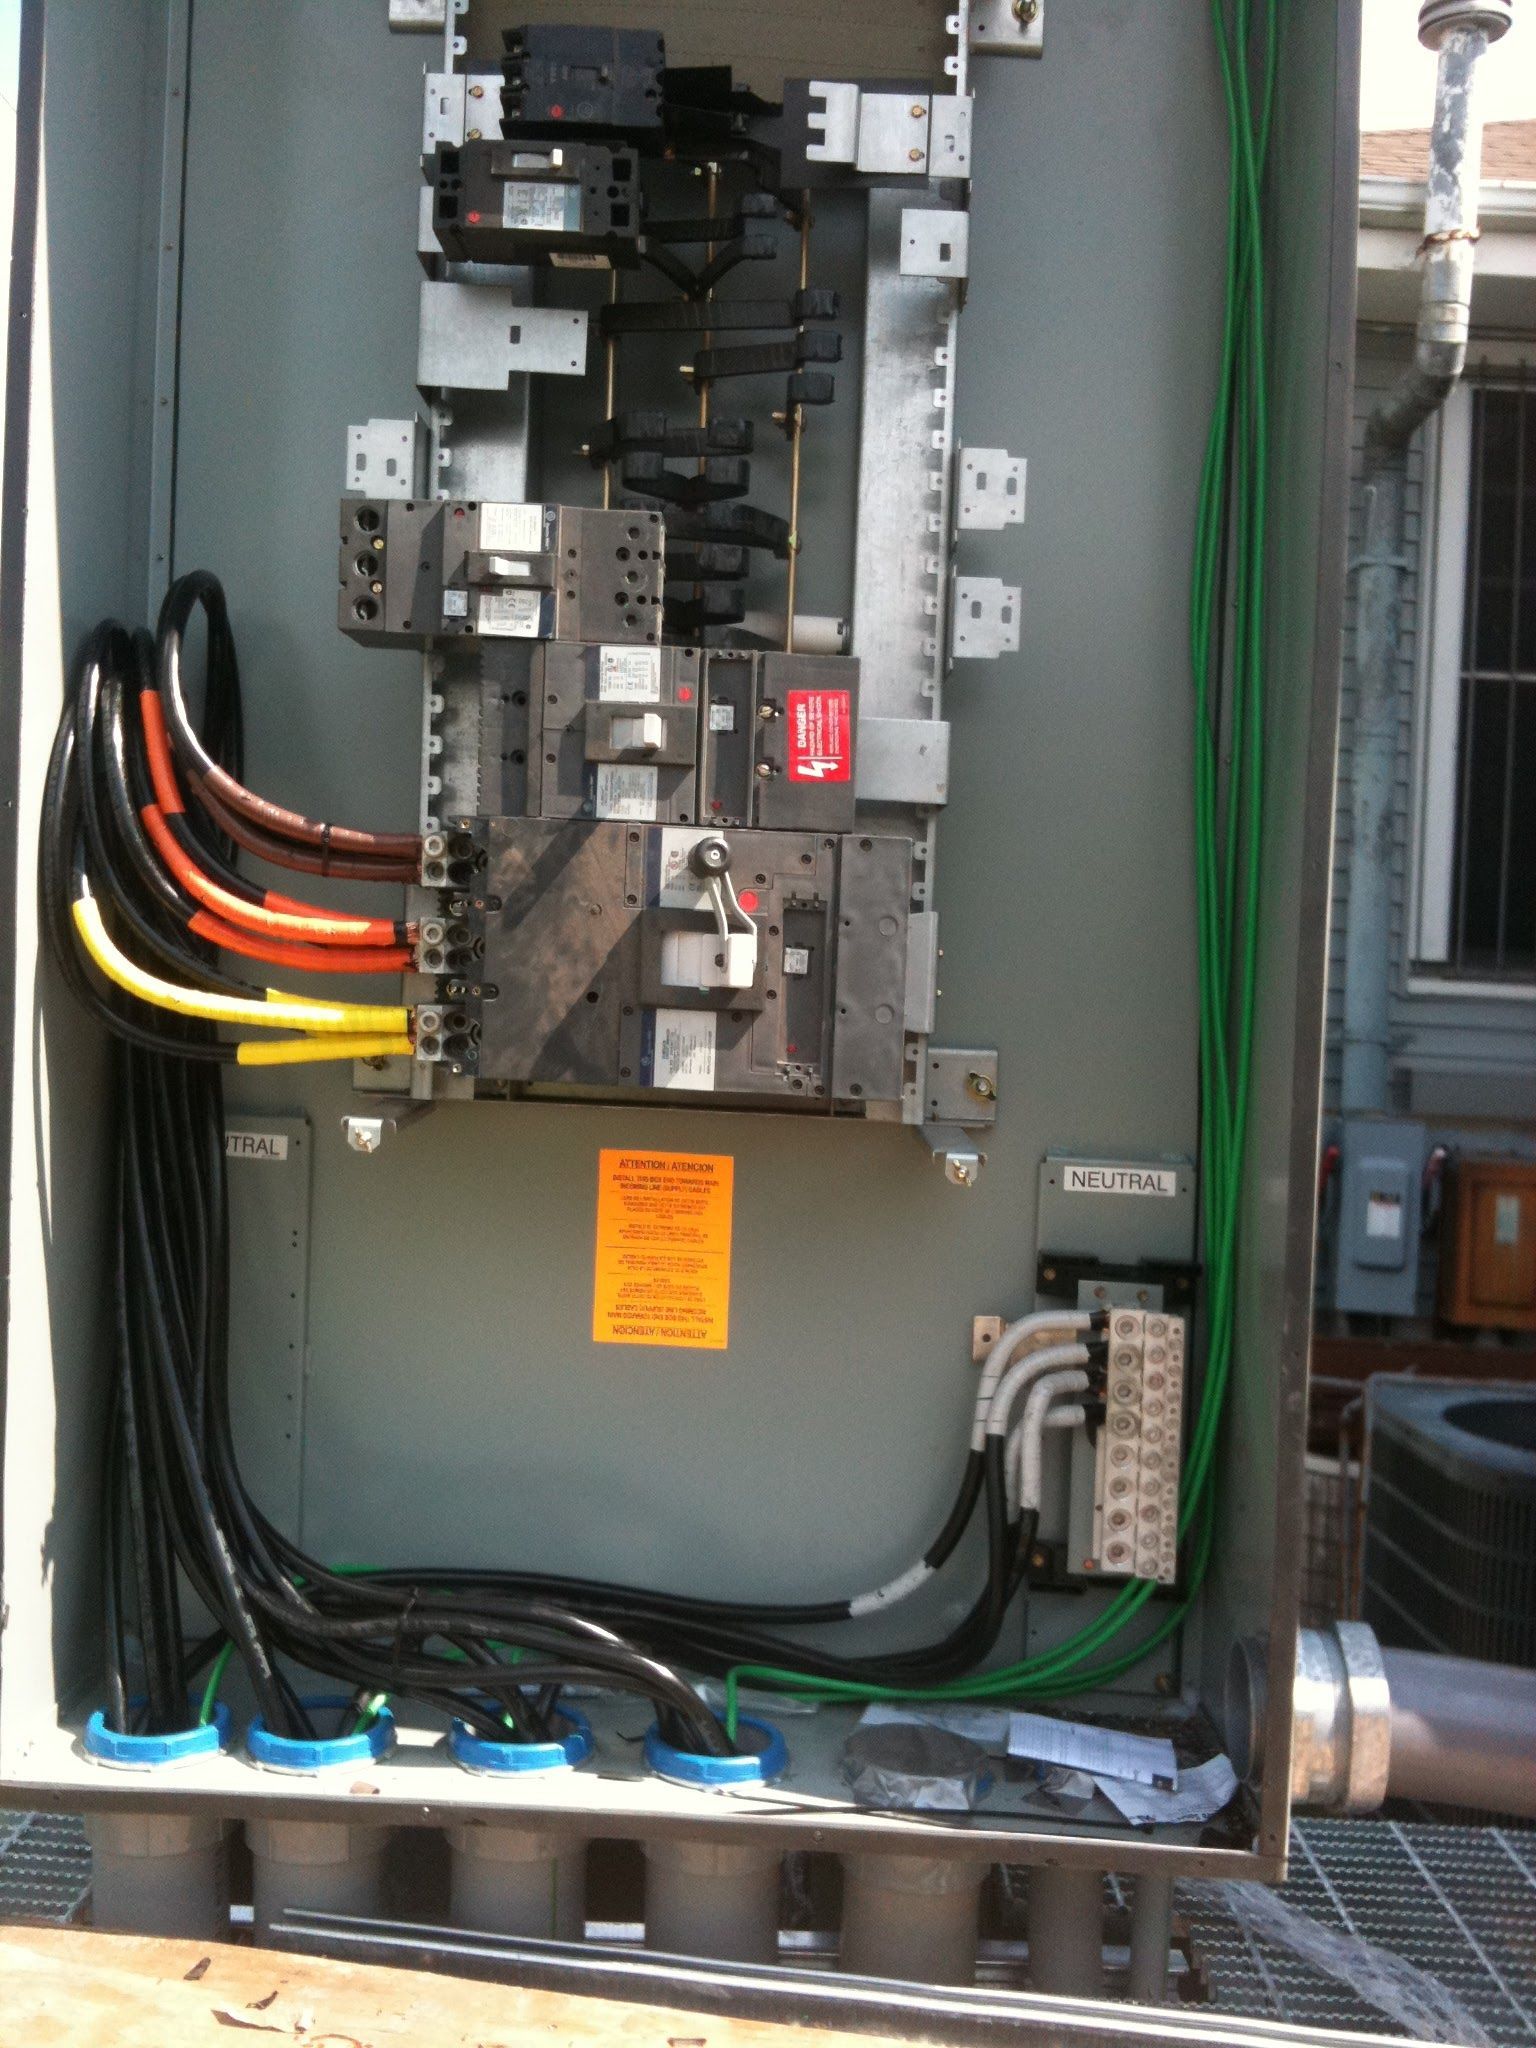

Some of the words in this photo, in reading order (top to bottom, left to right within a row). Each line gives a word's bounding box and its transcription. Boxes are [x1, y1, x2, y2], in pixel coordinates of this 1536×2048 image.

[797, 704, 806, 748] DANGER
[619, 1160, 666, 1170] ATTENTION
[672, 1162, 714, 1172] ATENCION
[1072, 1170, 1167, 1192] NEUTRAL
[612, 1325, 655, 1336] ATENCION
[660, 1328, 708, 1338] ATTENTION
